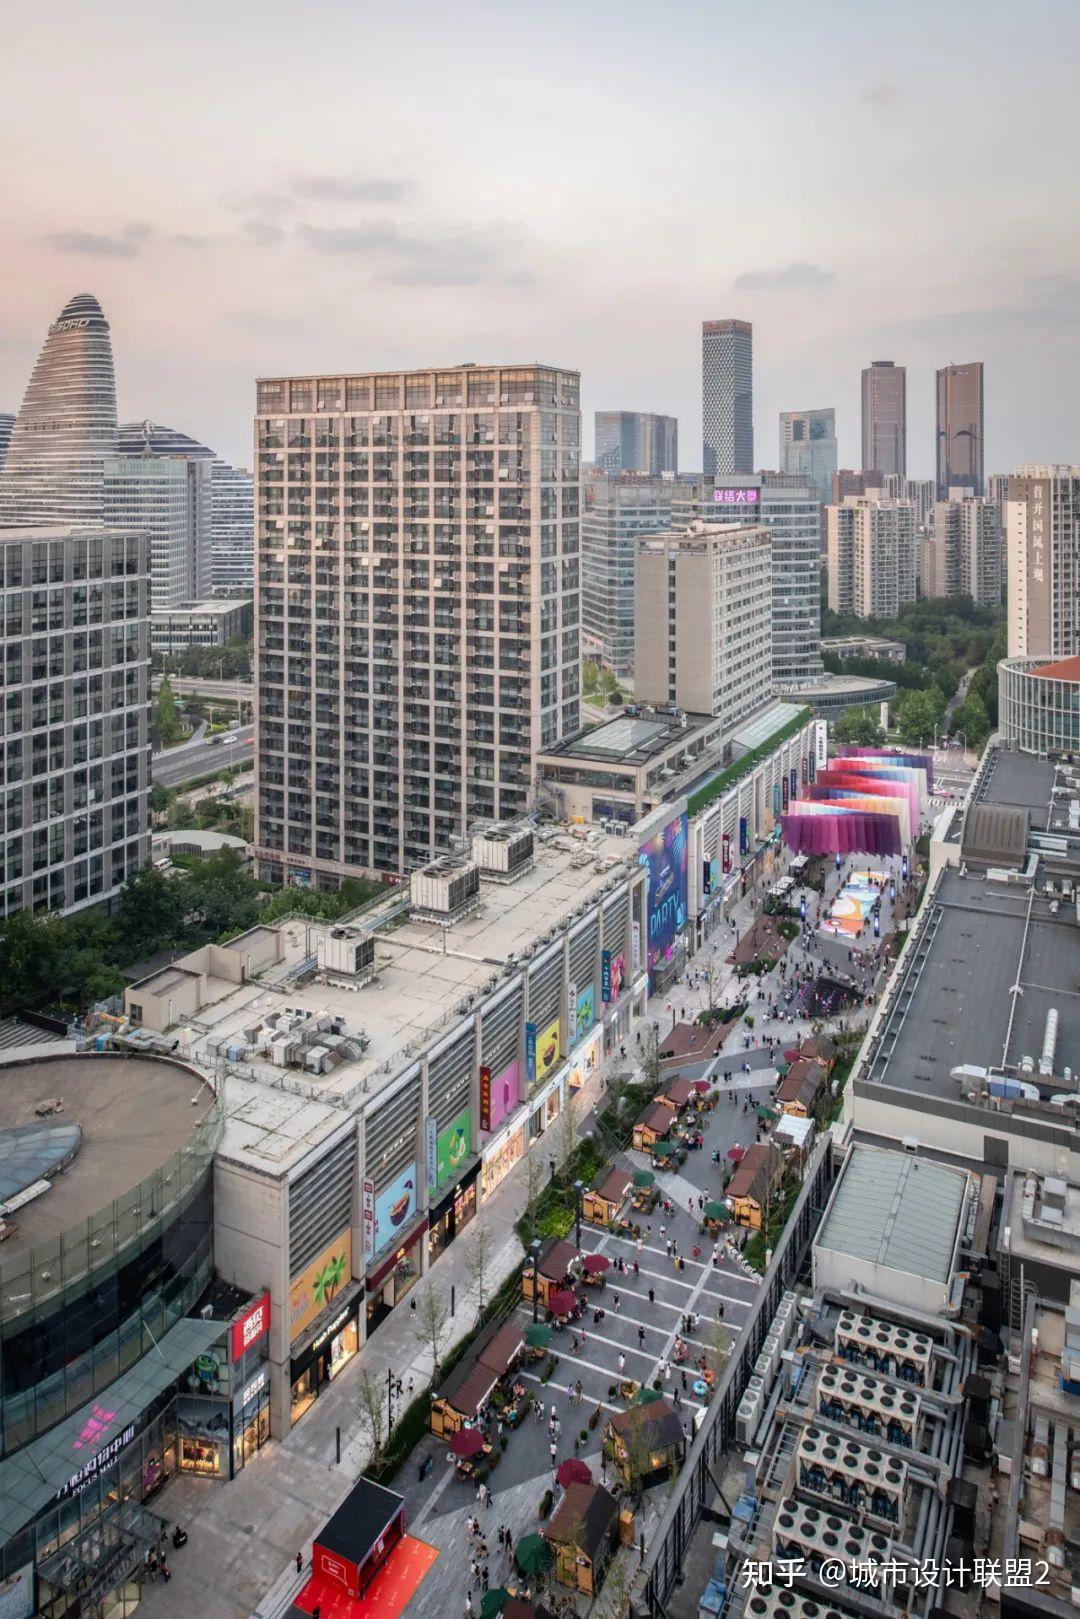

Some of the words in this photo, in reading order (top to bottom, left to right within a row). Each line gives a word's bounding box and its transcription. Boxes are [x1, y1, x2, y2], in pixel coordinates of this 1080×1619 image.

[713, 489, 758, 503] 联络大厦
[72, 1472, 98, 1498] FOCUS
[99, 1455, 119, 1474] MALL
